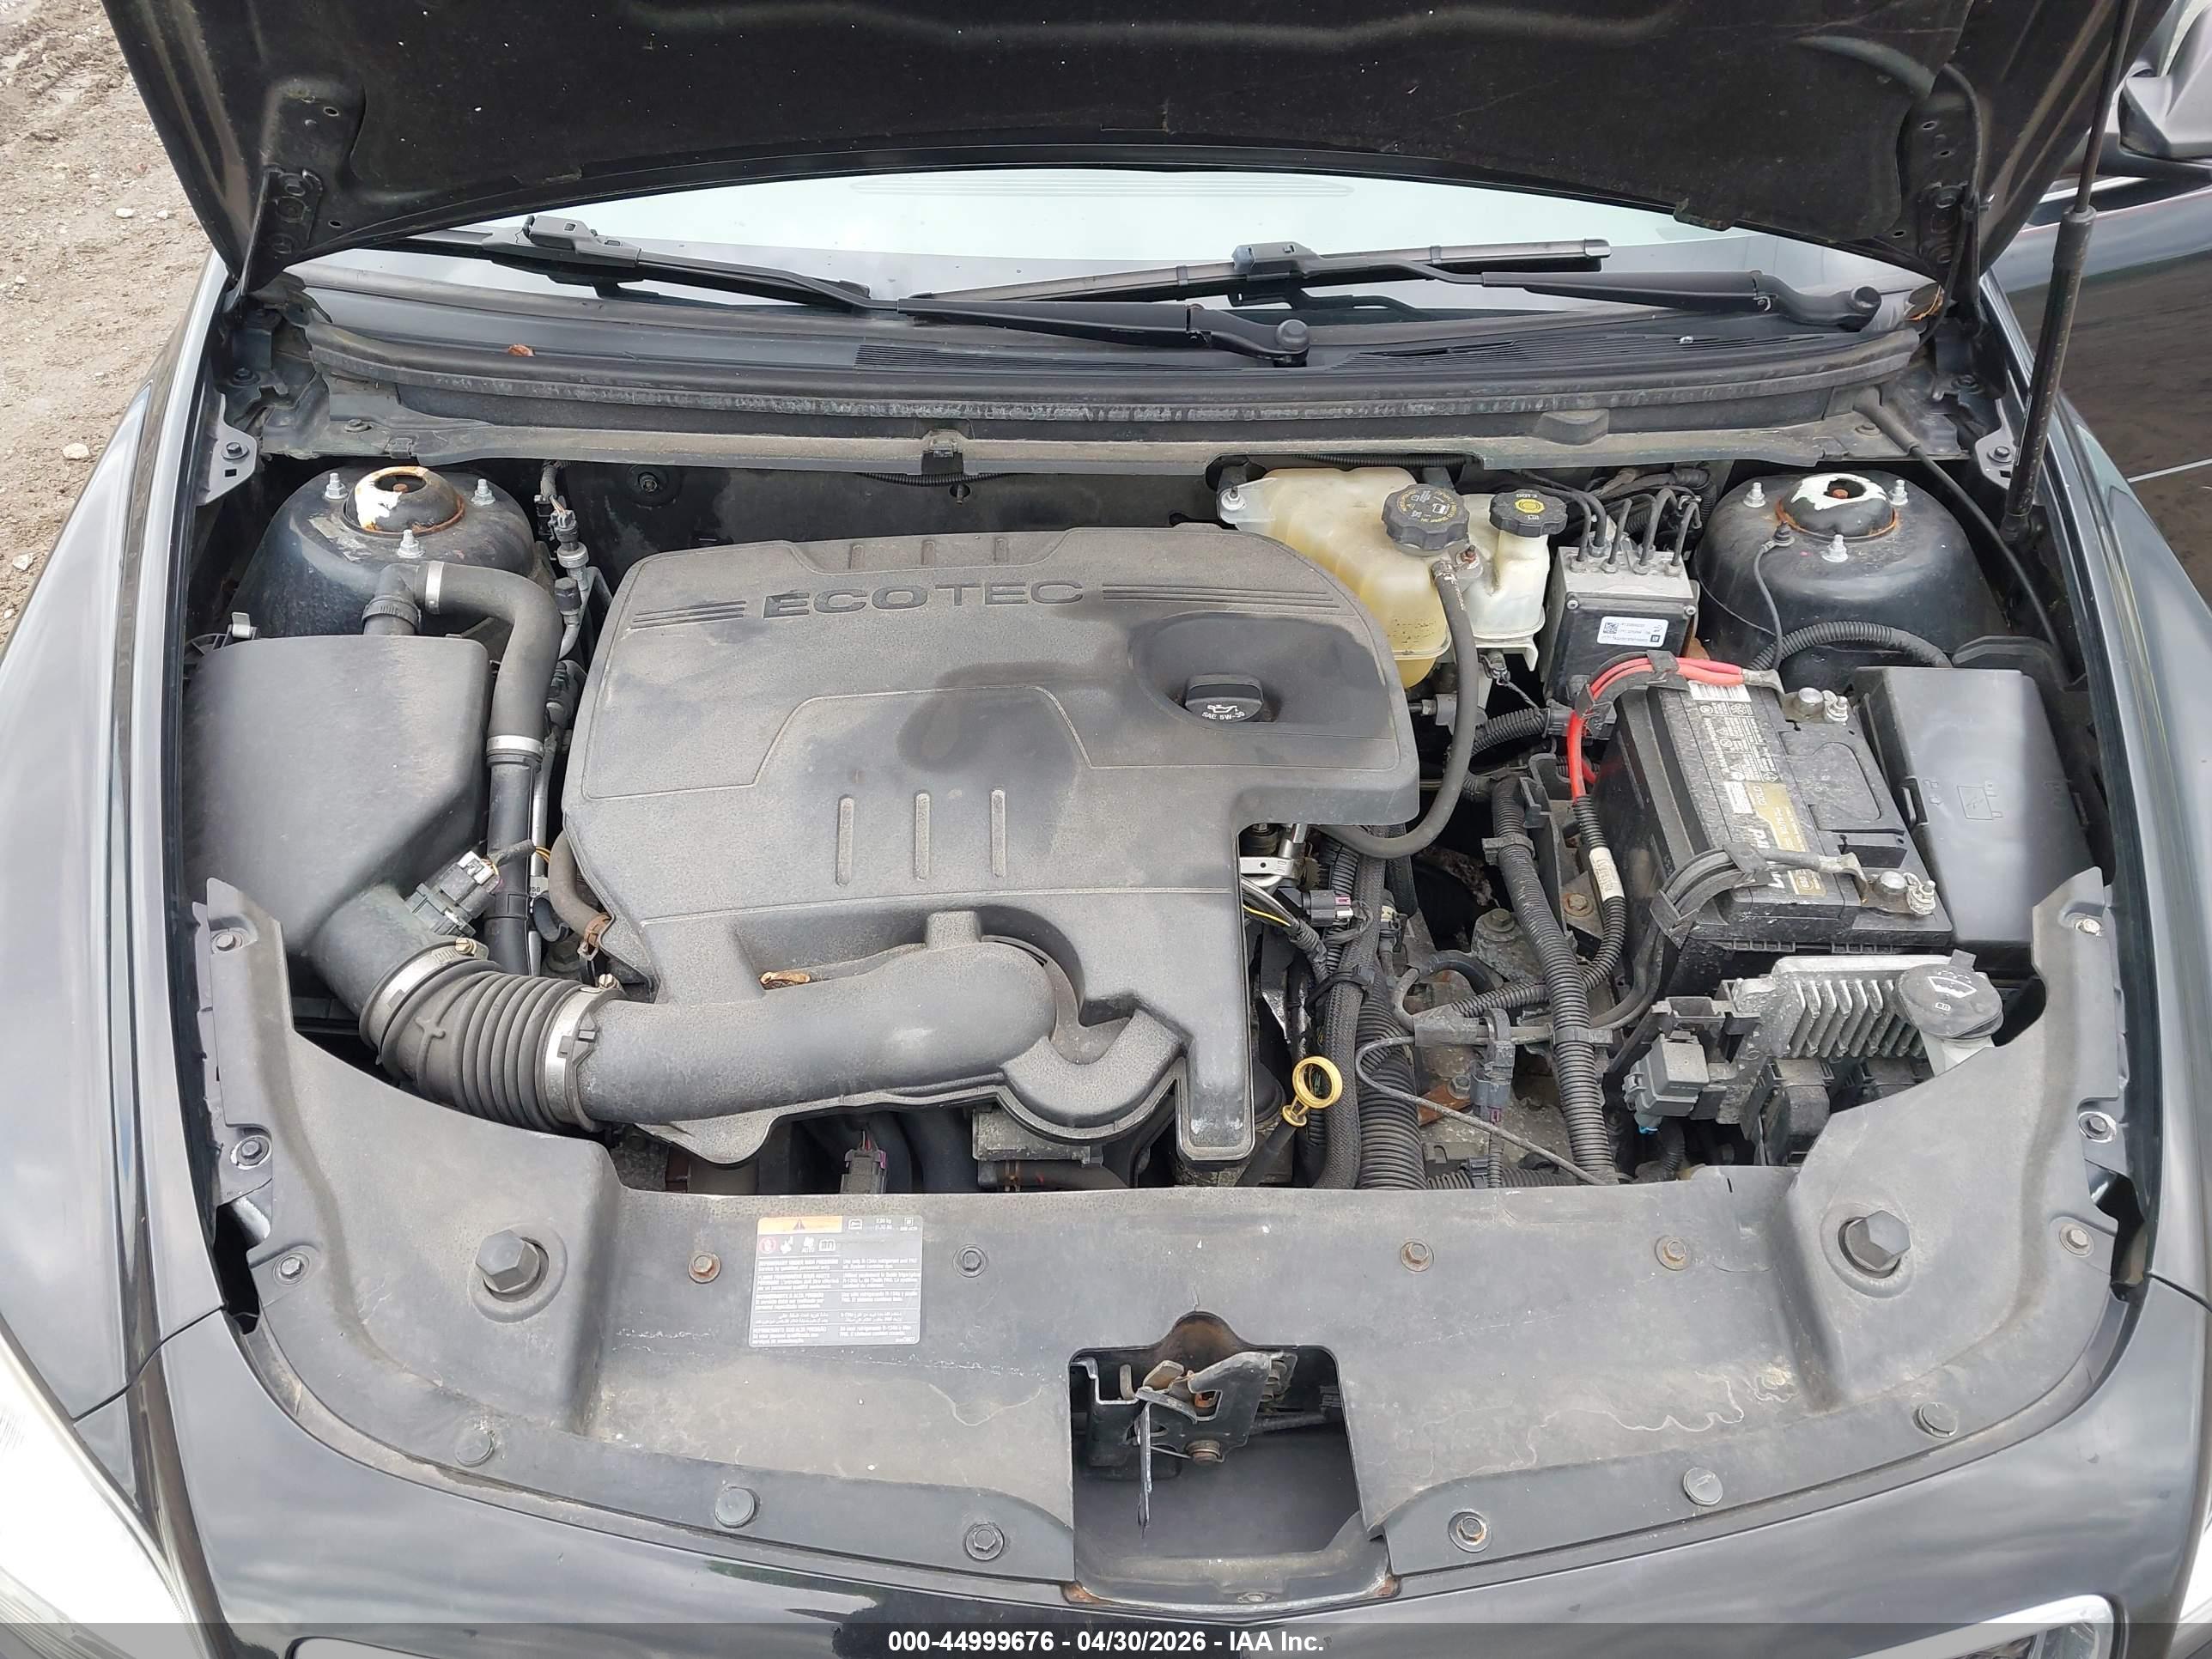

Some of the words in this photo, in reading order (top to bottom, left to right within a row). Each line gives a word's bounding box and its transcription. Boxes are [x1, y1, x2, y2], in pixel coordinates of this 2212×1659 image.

[762, 579, 1084, 619] ECOTEC
[1201, 711, 1218, 720] SAE
[1753, 785, 1767, 805] GOLD
